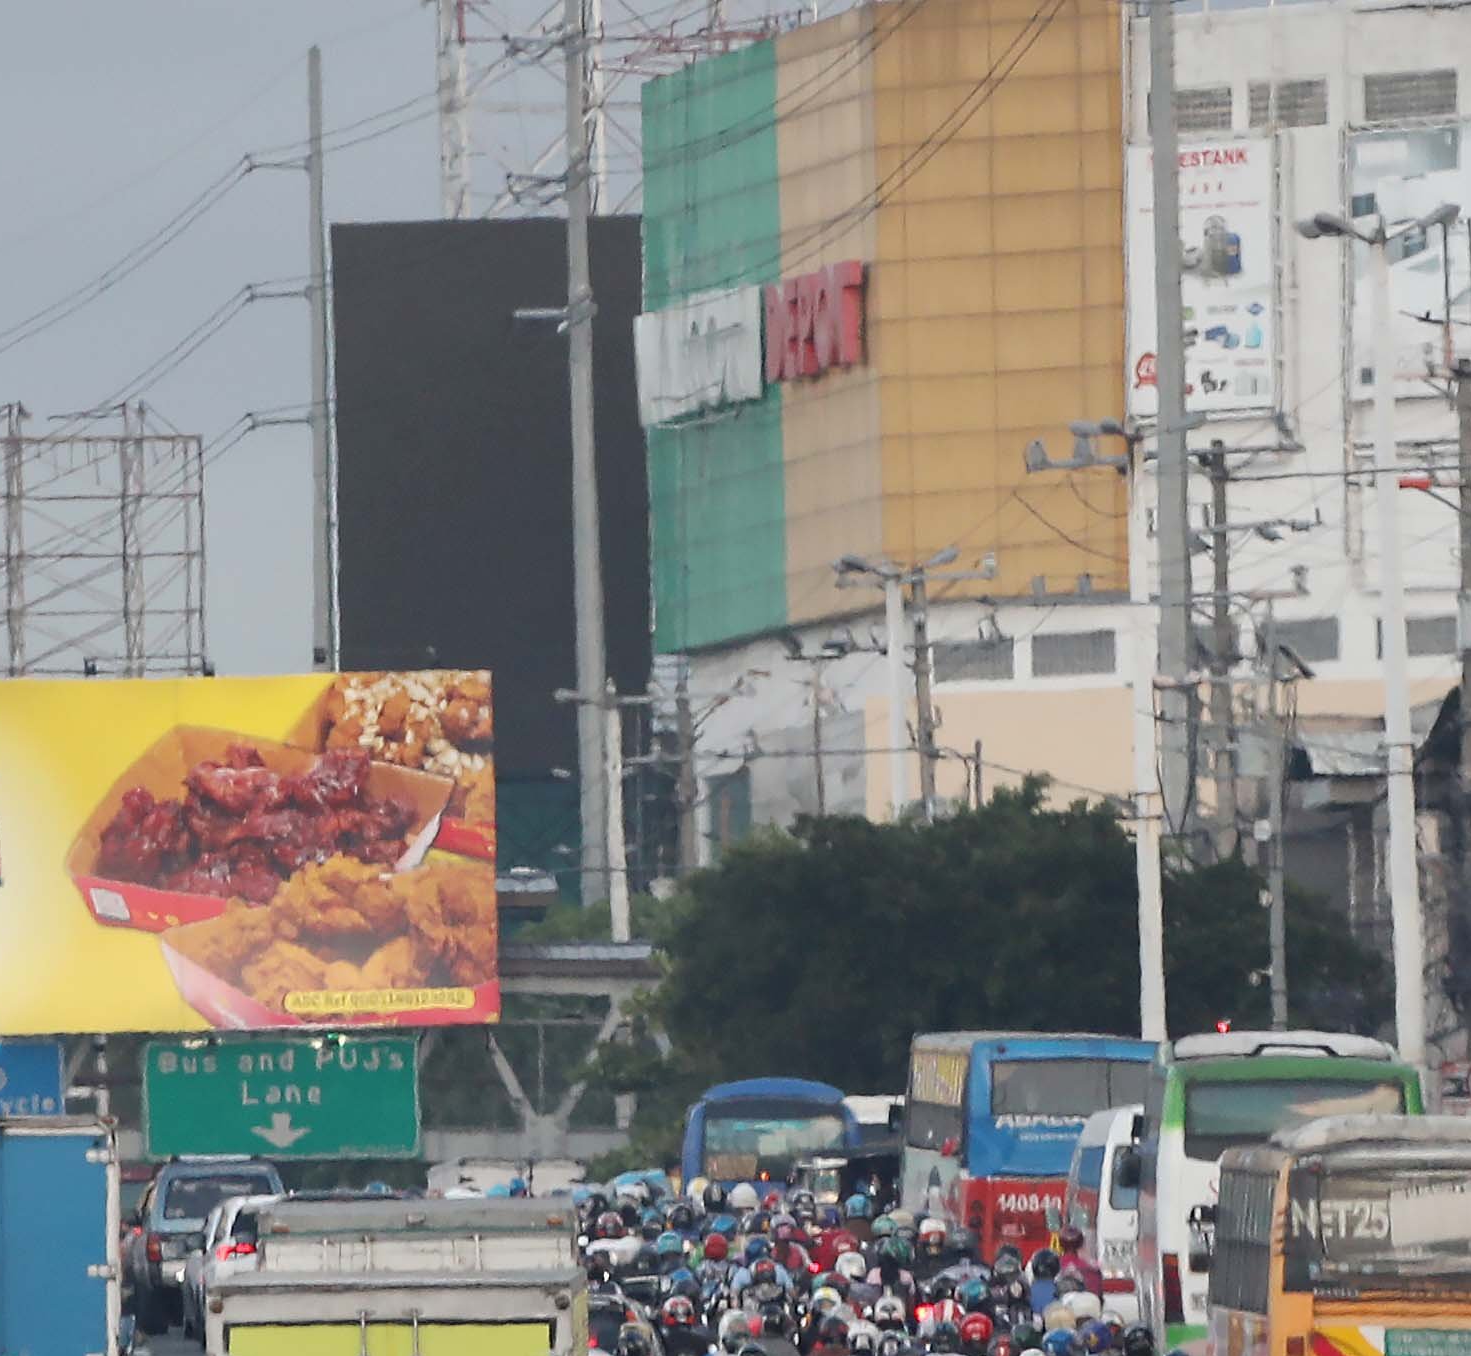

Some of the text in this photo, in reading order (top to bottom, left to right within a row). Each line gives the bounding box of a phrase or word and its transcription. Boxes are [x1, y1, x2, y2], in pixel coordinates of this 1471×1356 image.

[158, 1052, 218, 1073] Bus
[239, 1048, 294, 1071] and
[242, 1081, 322, 1106] Lane
[1291, 1197, 1389, 1241] NET25
